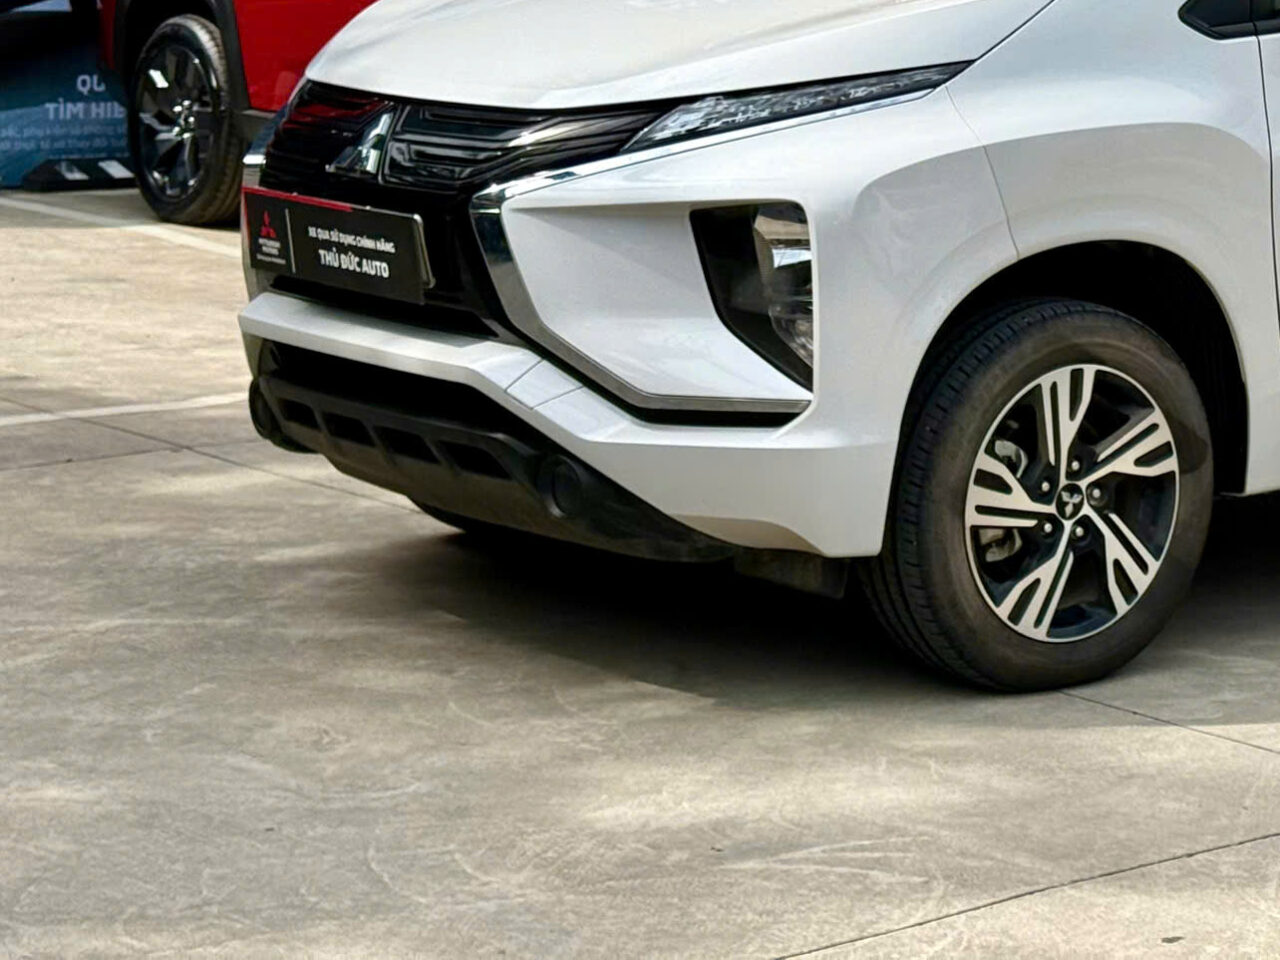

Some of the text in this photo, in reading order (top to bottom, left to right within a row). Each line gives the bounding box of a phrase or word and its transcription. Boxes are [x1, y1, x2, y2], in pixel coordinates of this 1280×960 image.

[45, 97, 84, 119] TÌM
[317, 228, 330, 240] QUA
[318, 247, 390, 278] THỦ ĐỨC AUTO
